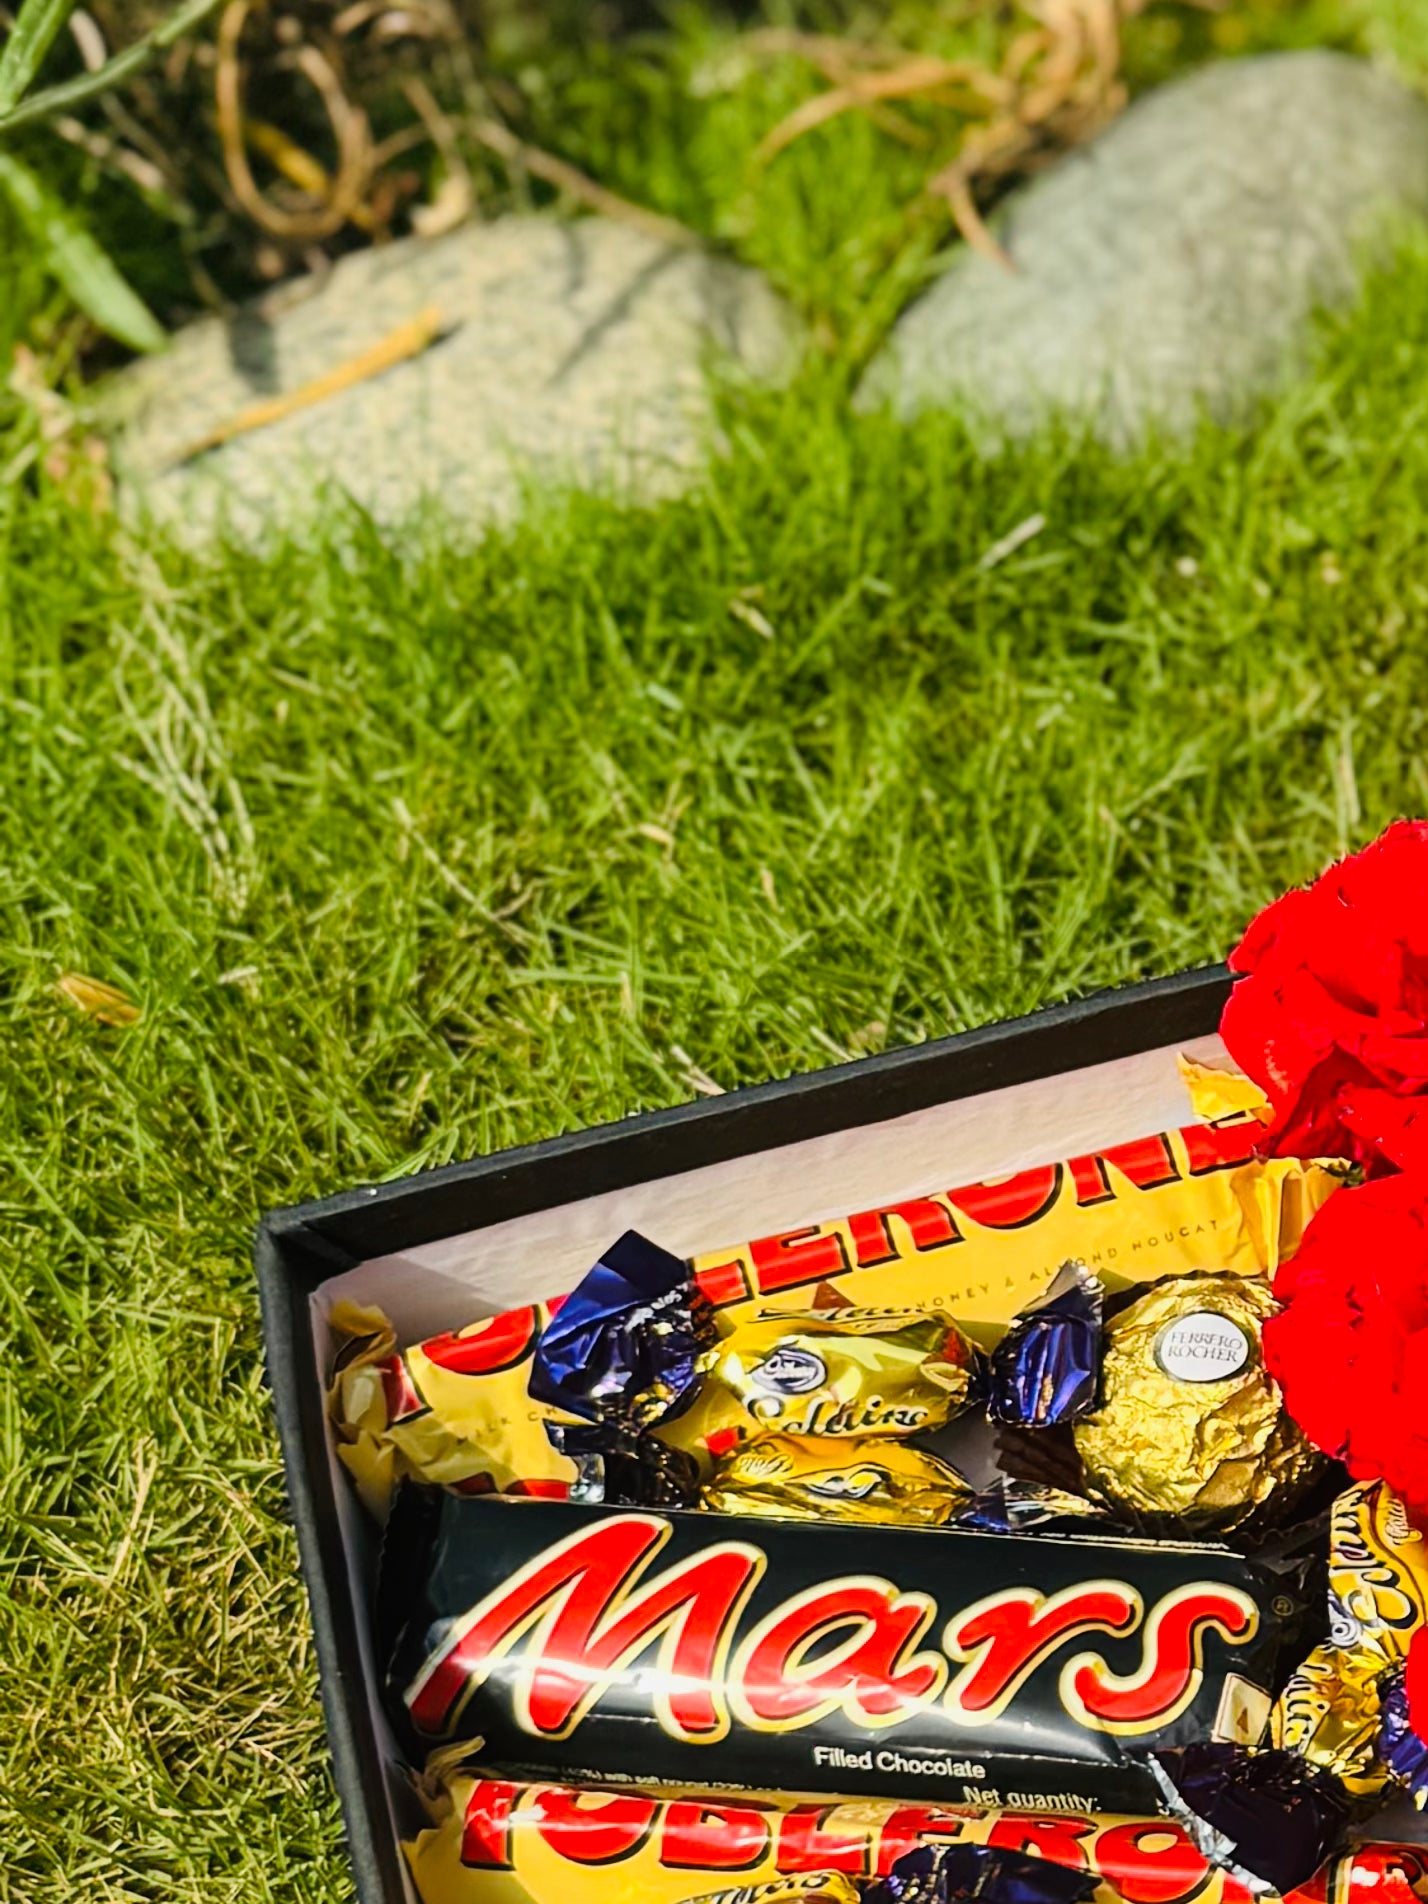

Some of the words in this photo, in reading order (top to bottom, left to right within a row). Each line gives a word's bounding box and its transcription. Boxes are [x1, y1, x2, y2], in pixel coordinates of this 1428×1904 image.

[1169, 1329, 1245, 1353] FERRERO
[1166, 1343, 1239, 1366] ROCHER
[405, 1513, 1259, 1744] Mars
[814, 1745, 872, 1773] Filled
[879, 1751, 986, 1781] Chocolate
[962, 1784, 1001, 1807] Net
